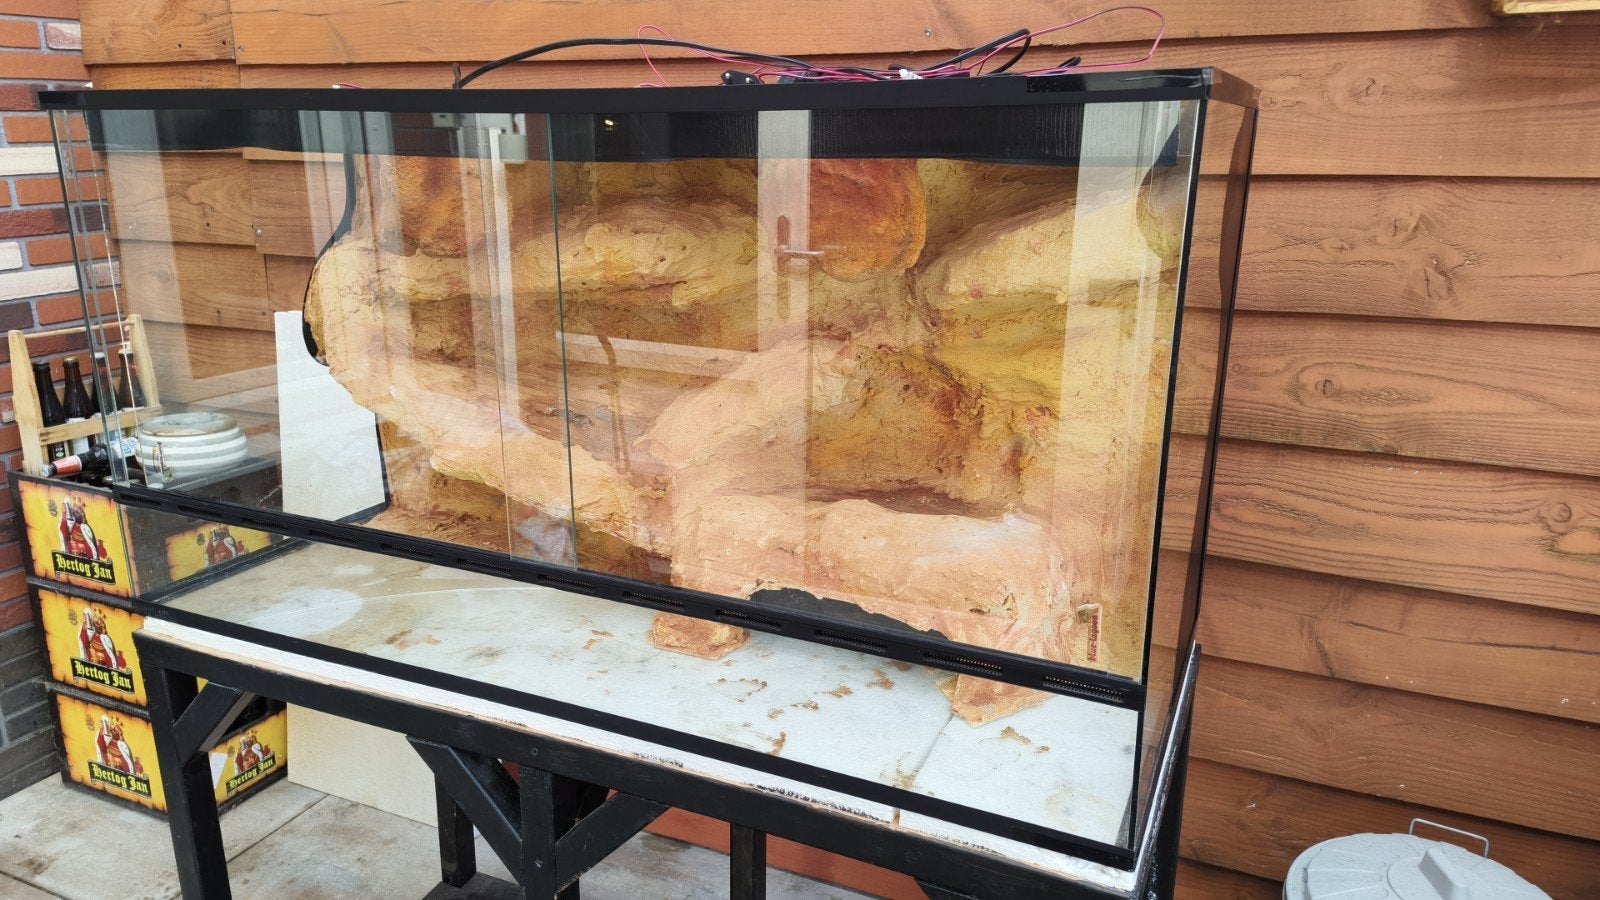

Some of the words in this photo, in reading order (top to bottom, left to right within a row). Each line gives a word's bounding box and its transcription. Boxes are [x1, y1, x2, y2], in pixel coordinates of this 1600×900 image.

[56, 554, 91, 576] Hertog
[93, 562, 112, 580] Jan
[75, 660, 110, 685] Hertog
[112, 671, 131, 689] Jan
[93, 763, 128, 788] Hertog
[129, 774, 149, 793] Jan
[230, 770, 258, 790] Hertog
[259, 760, 274, 774] Jan
